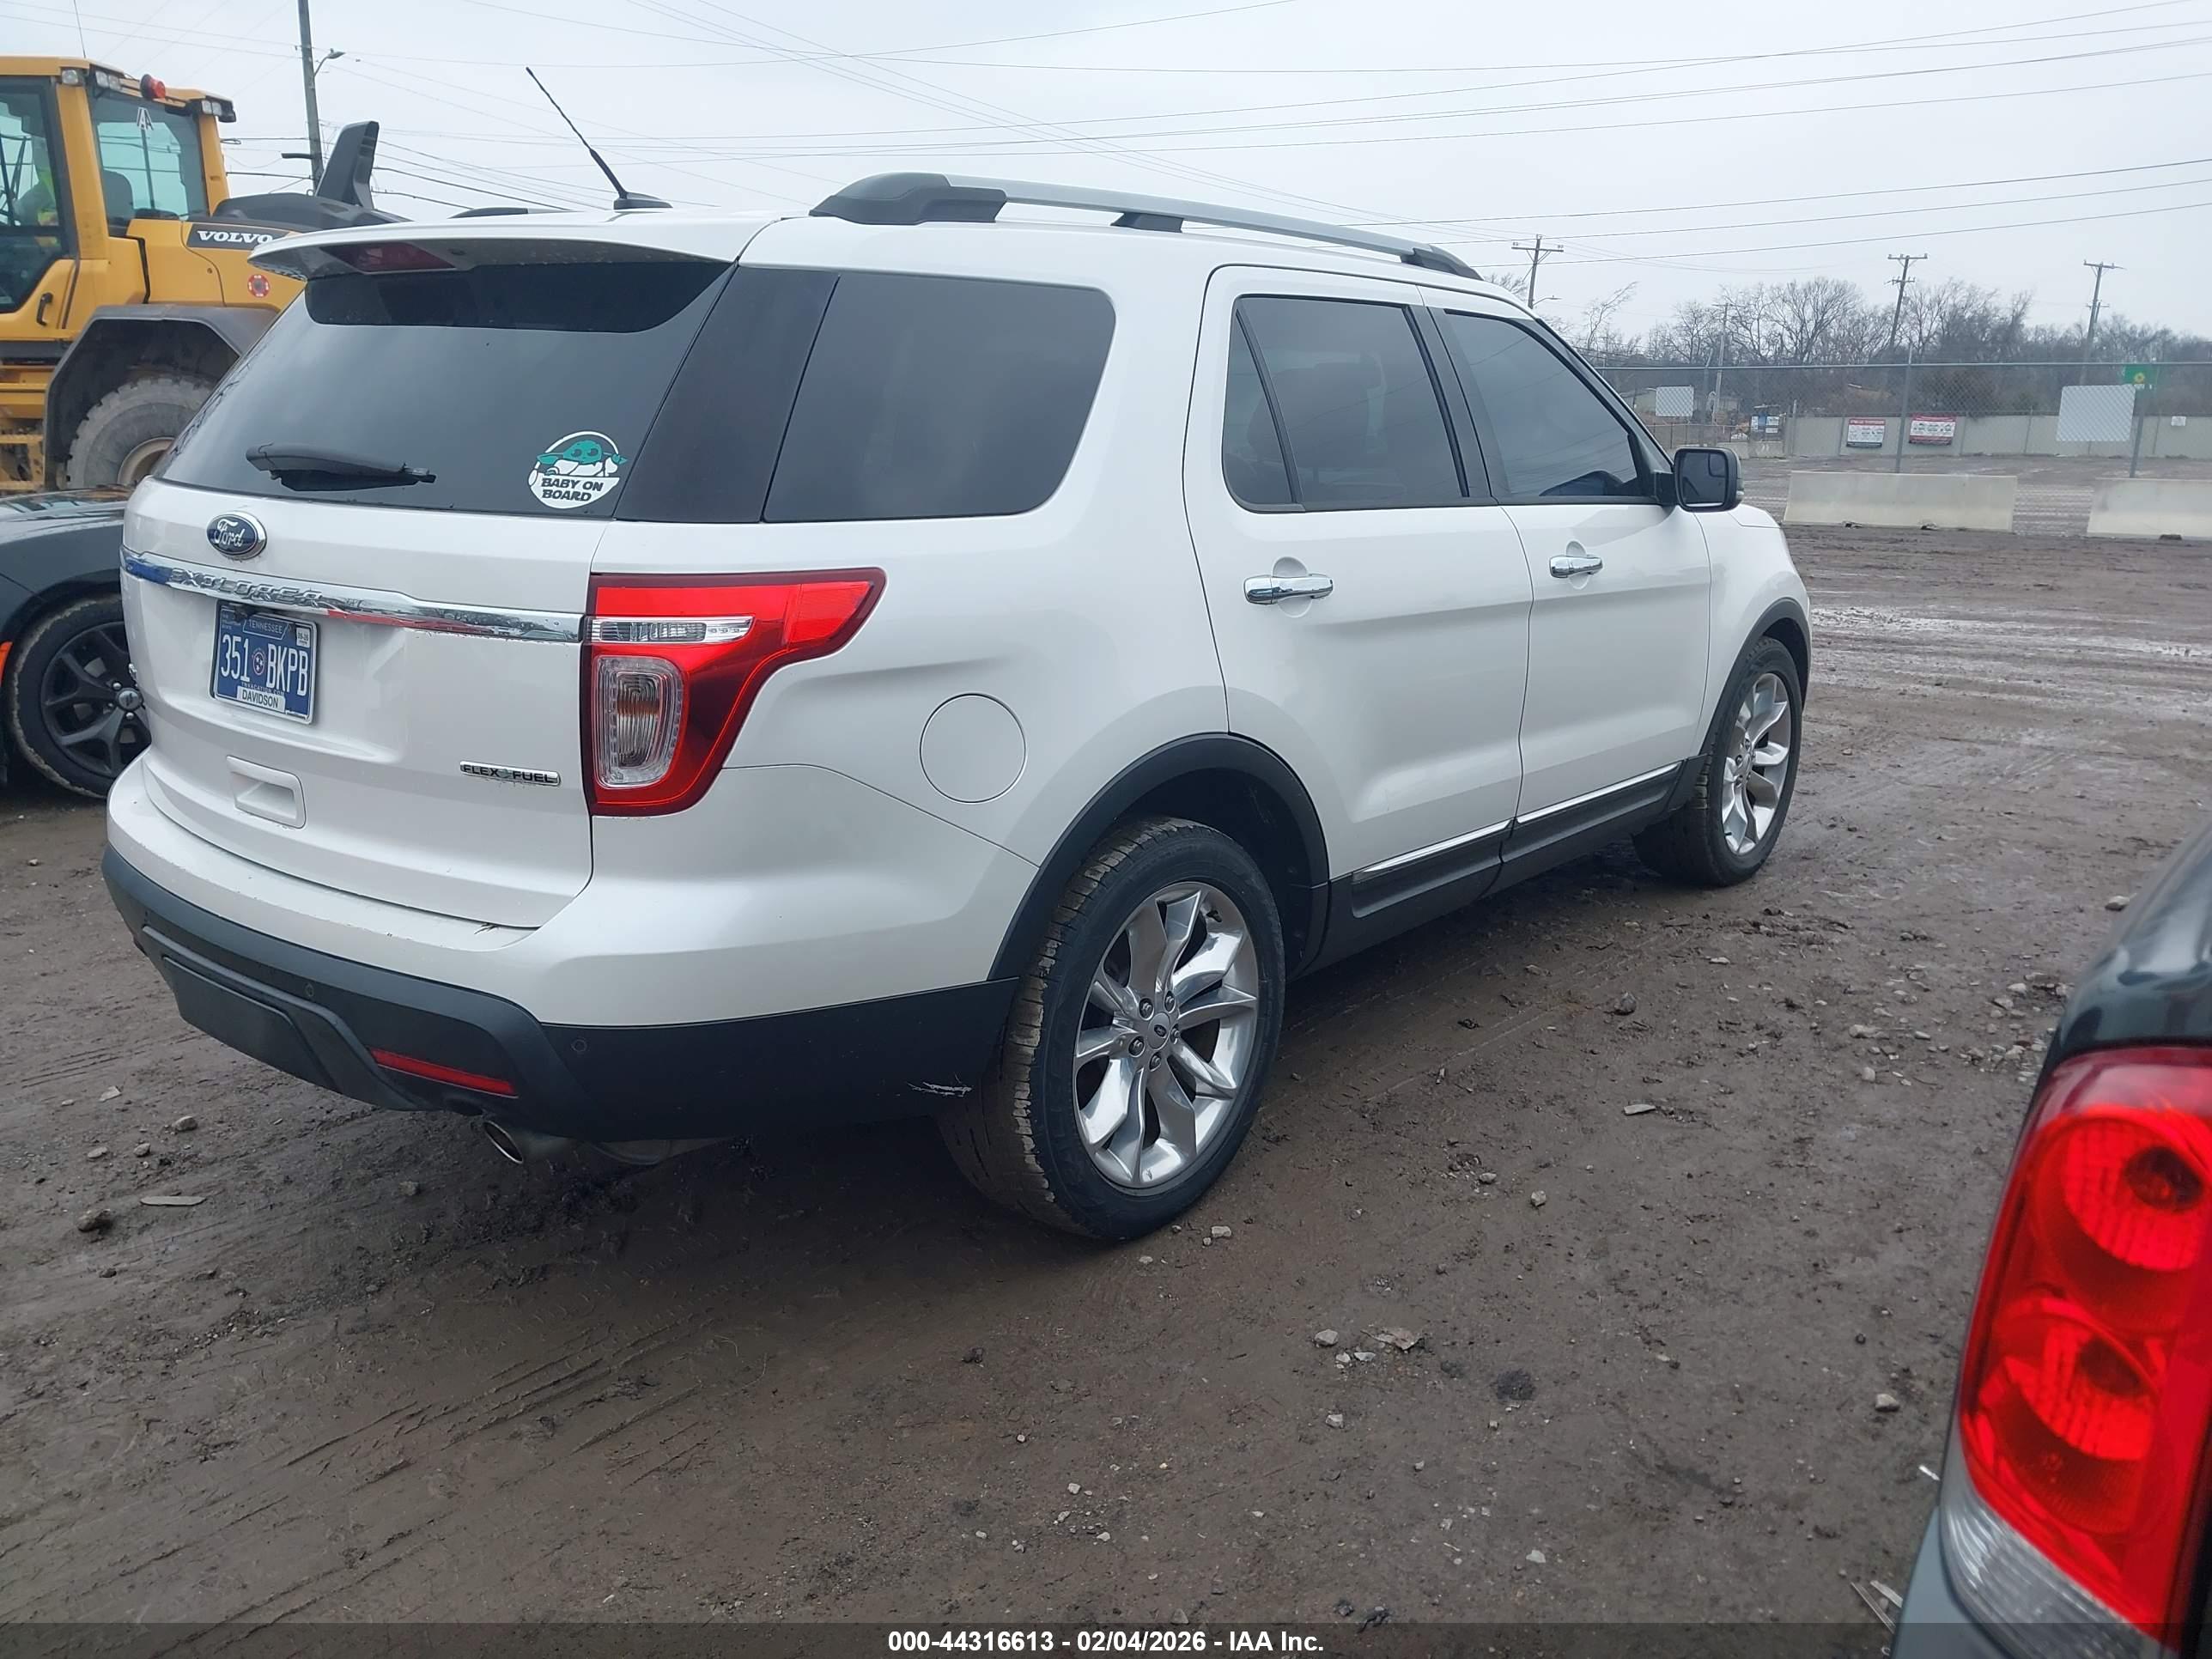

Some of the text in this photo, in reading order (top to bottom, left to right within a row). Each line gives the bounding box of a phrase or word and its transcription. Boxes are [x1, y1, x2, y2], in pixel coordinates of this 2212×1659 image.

[198, 230, 273, 244] VOLVO
[541, 477, 604, 492] BABY ON
[542, 489, 592, 501] BOARD
[211, 519, 246, 547] Ford
[169, 567, 323, 608] EXPLORER
[248, 619, 283, 635] TENNESSEE
[221, 634, 309, 696] 351 BKPB
[242, 689, 279, 708] DAVIDSON
[463, 764, 557, 783] FLEX FUEL
